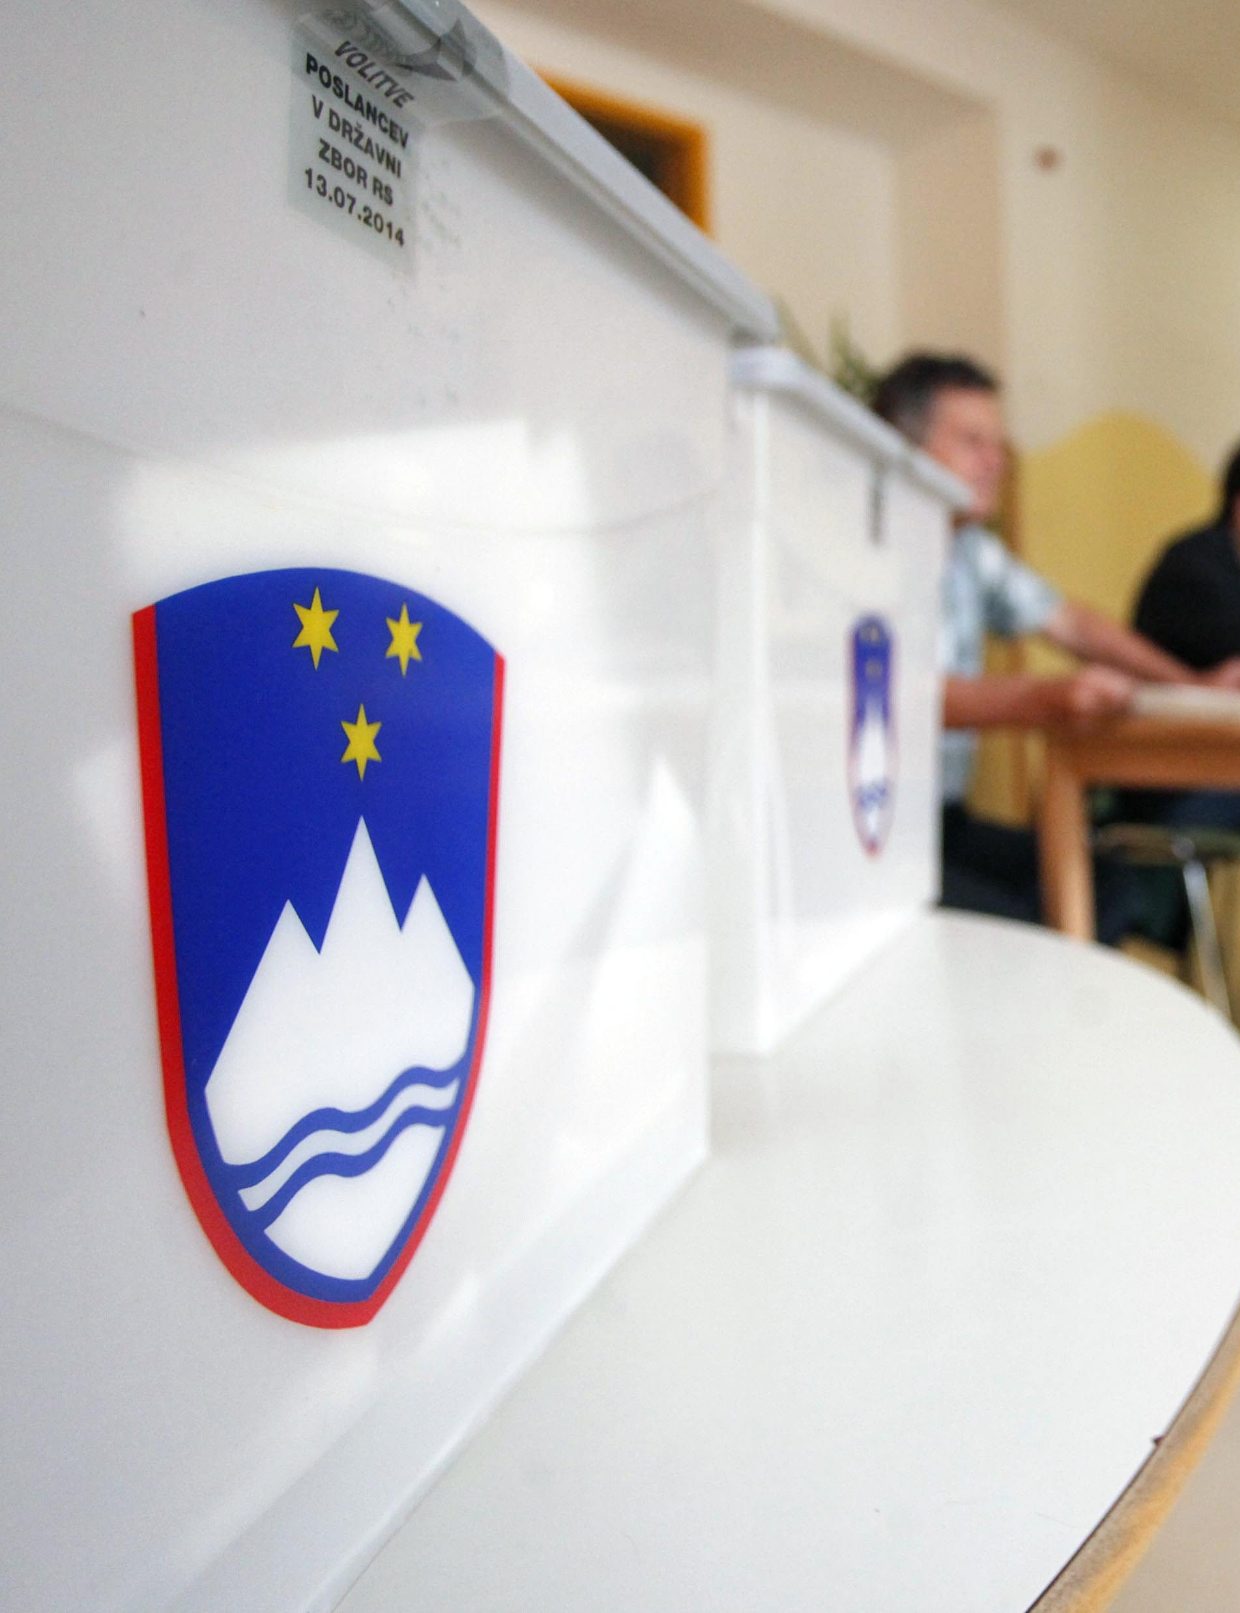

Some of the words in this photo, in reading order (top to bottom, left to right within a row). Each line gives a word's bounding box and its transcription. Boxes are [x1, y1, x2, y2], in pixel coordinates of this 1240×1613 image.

[306, 53, 409, 149] POSLANCEV
[334, 40, 415, 108] VOLITVE
[312, 94, 324, 119] V
[329, 108, 402, 178] DRŽAVNI
[318, 138, 368, 189] ZBOR
[372, 176, 394, 206] RS
[305, 168, 404, 247] 13.07.2014
